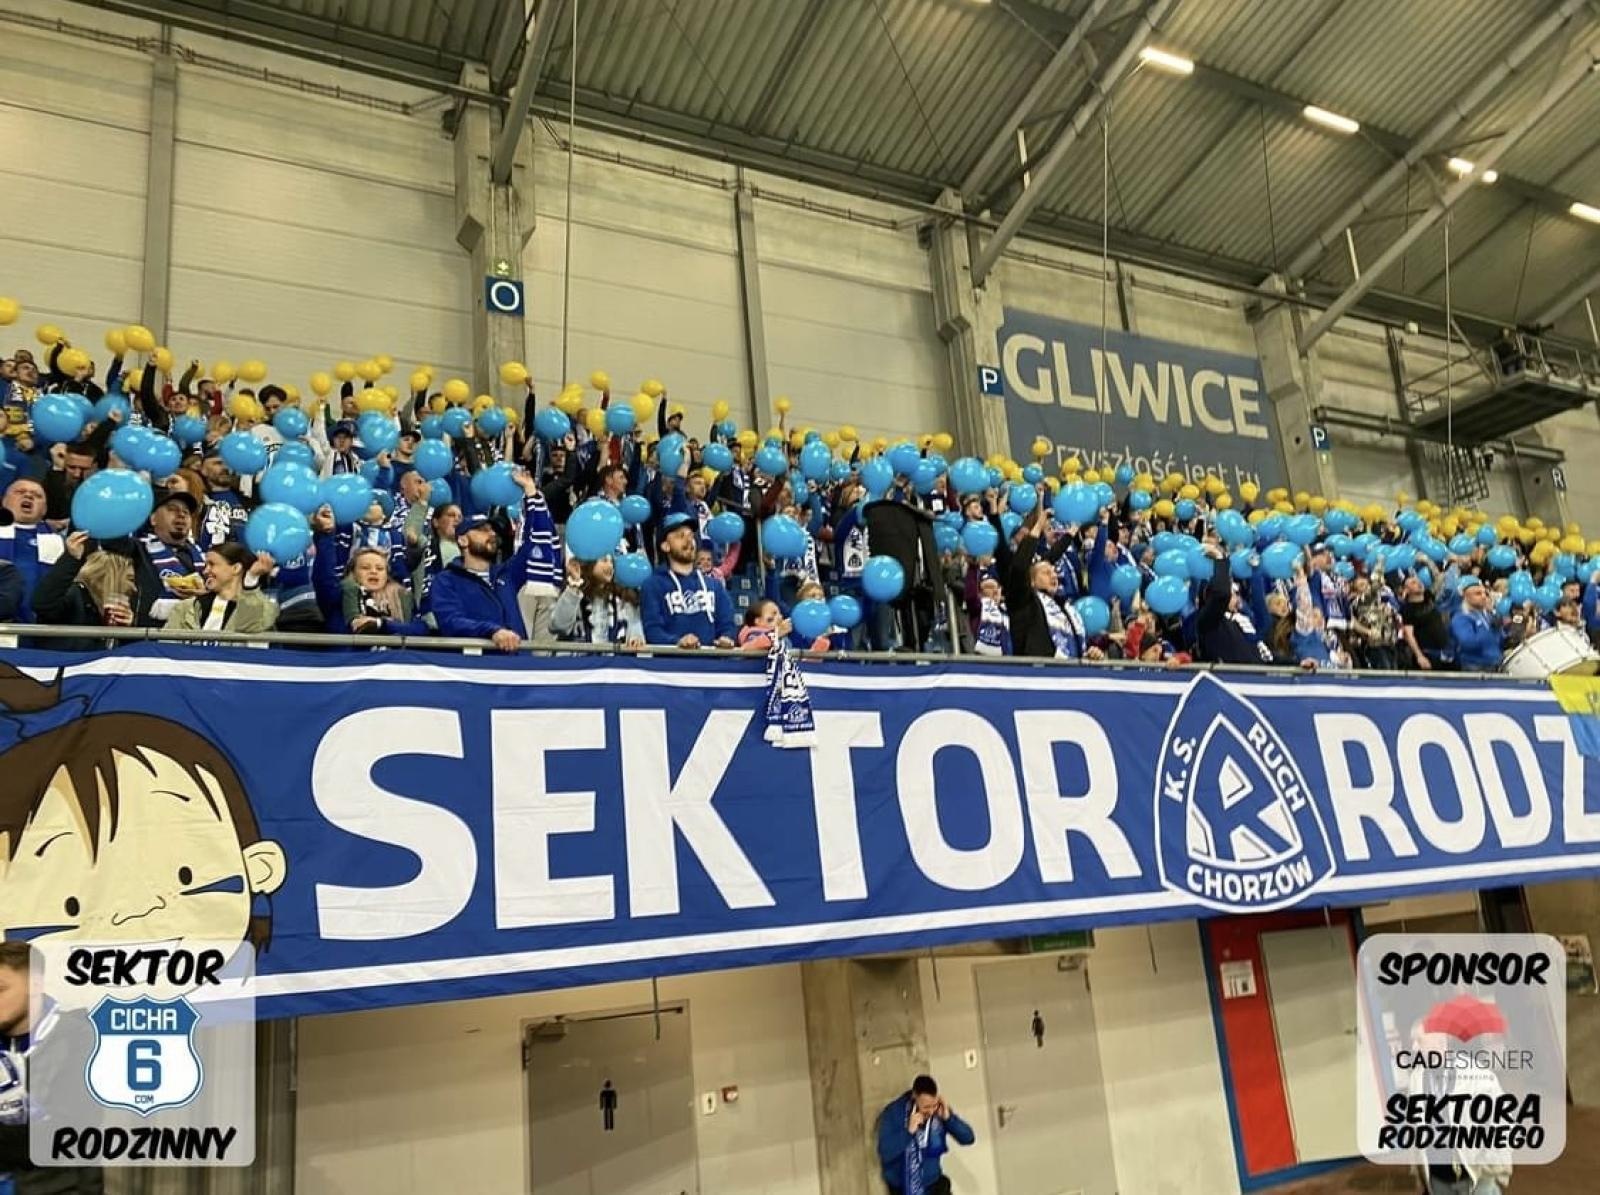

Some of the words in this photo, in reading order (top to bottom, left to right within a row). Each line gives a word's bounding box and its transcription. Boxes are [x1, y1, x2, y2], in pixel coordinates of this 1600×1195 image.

[982, 368, 998, 393] P
[1002, 333, 1269, 440] GLIWICE
[1313, 427, 1326, 448] P
[1248, 722, 1306, 812] RUCH
[312, 706, 1143, 941] SEKTOR
[1186, 855, 1314, 902] CHORZÓW
